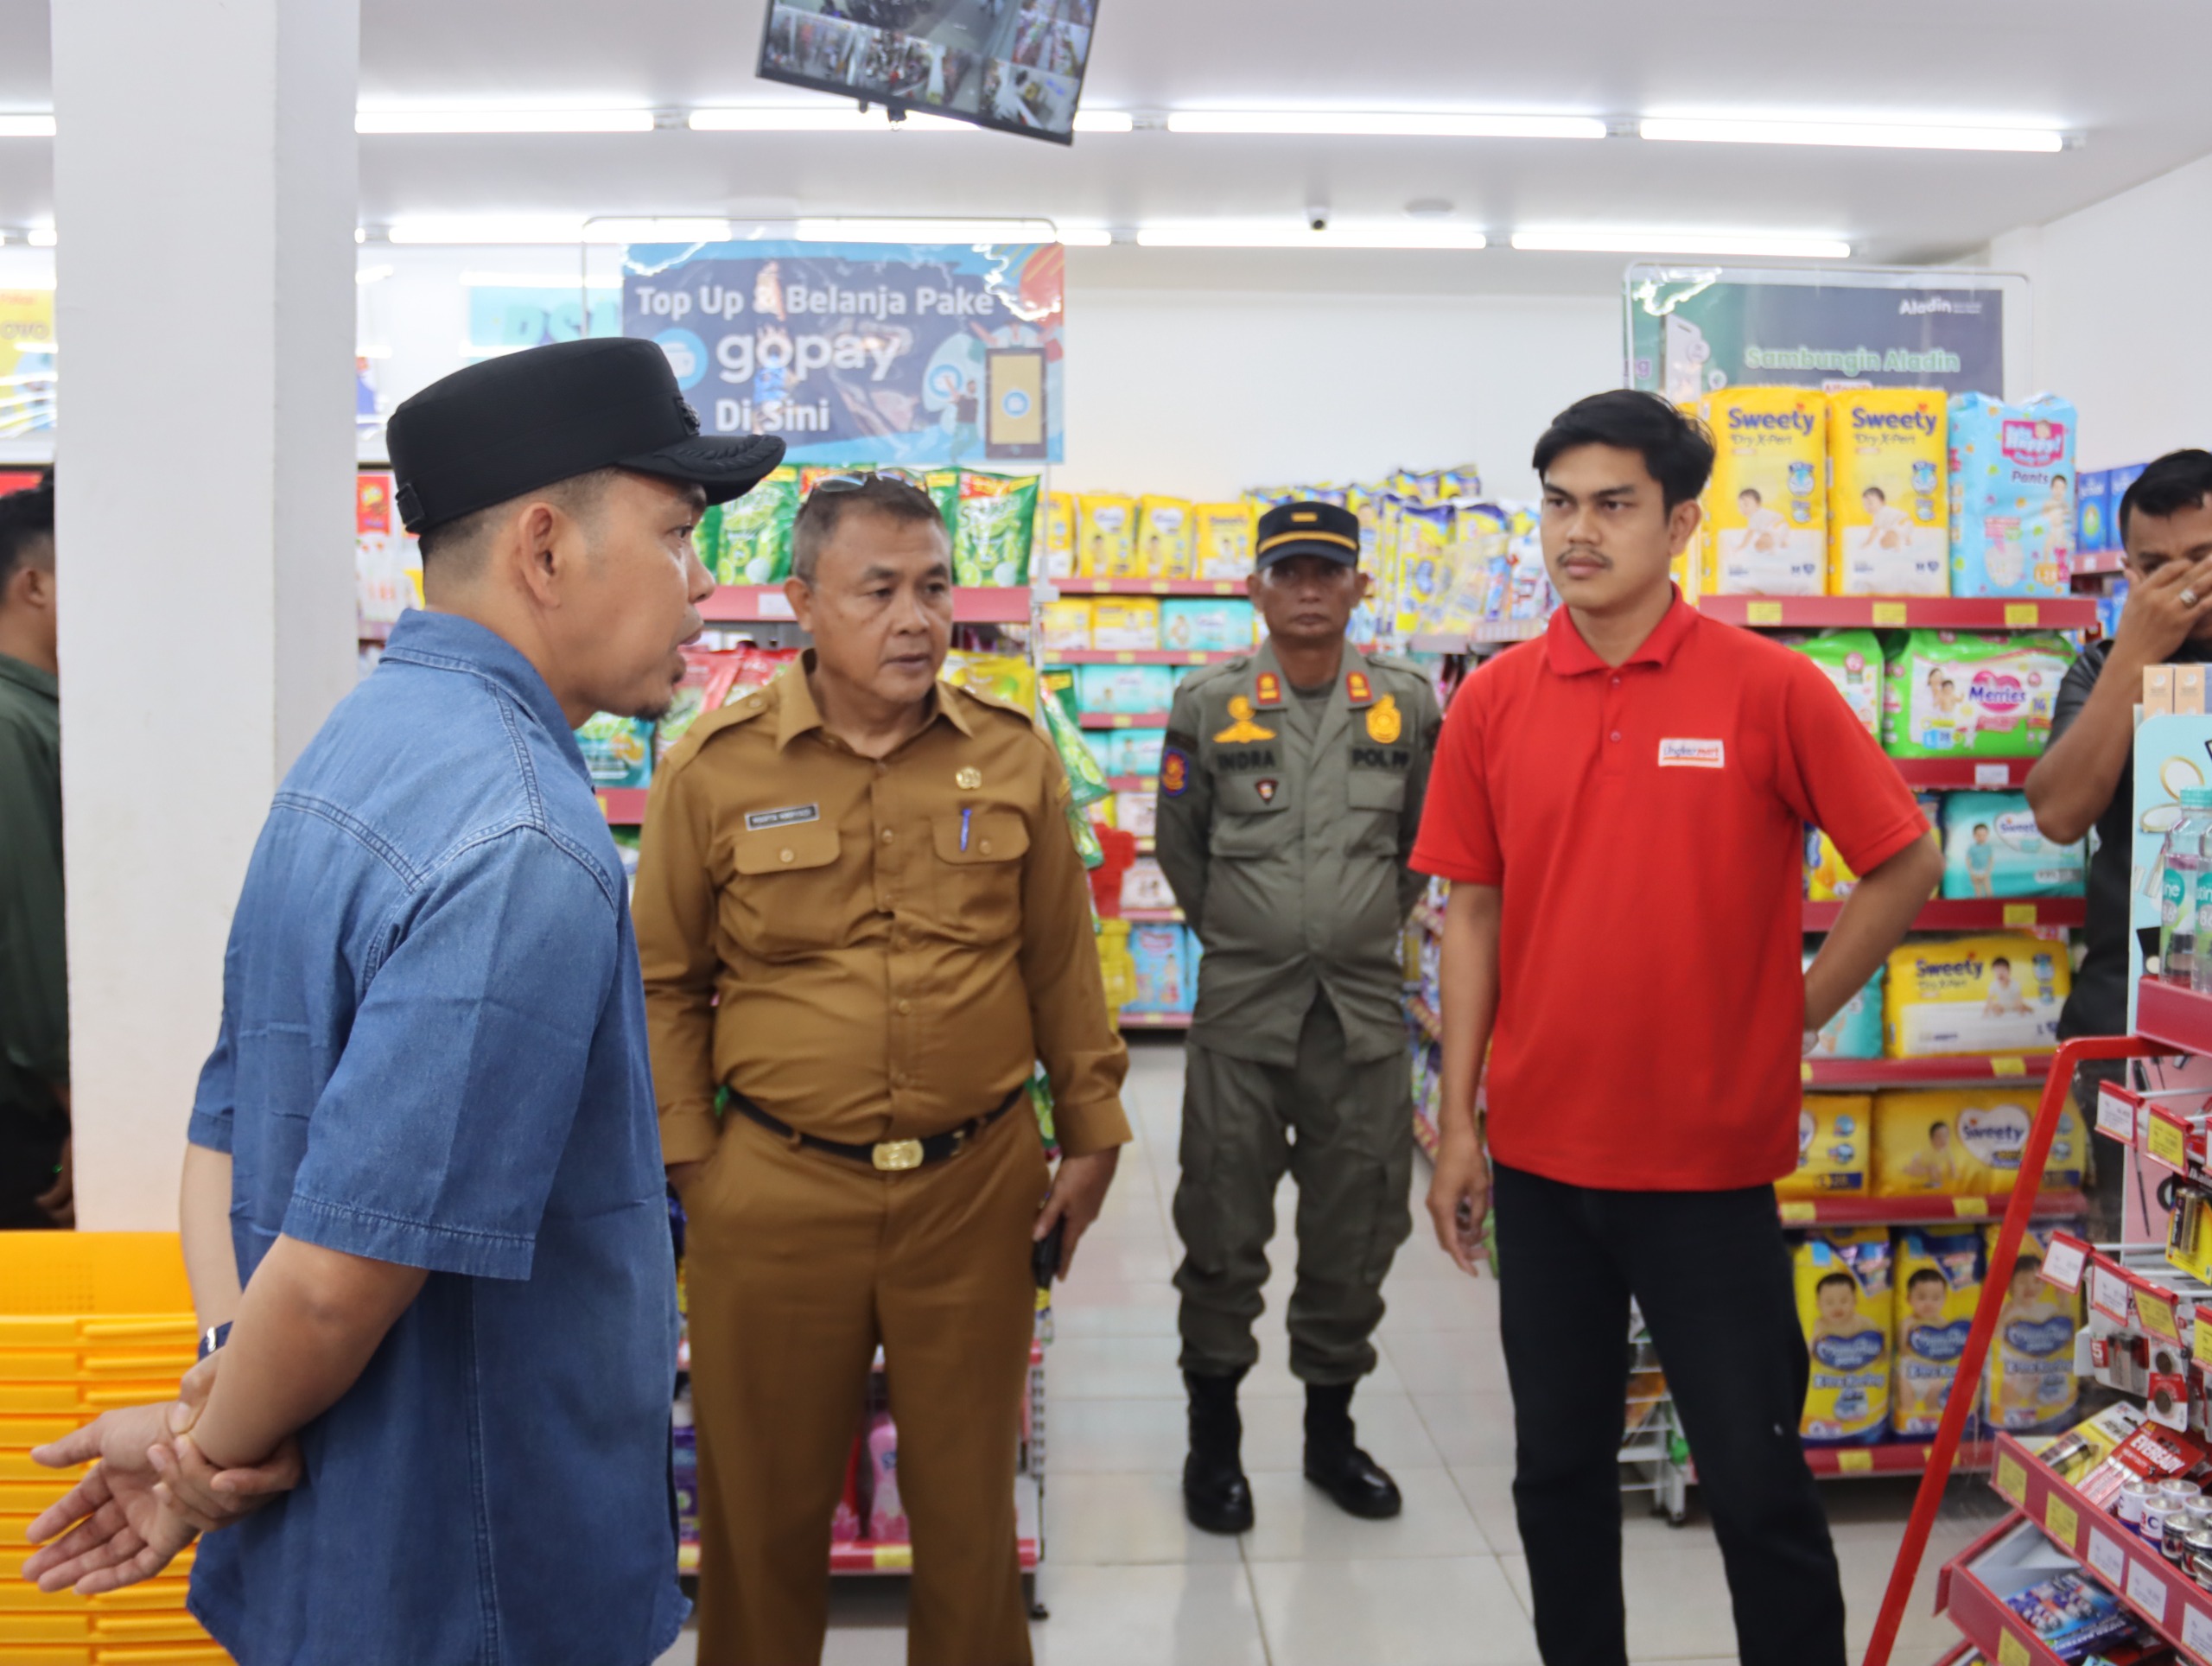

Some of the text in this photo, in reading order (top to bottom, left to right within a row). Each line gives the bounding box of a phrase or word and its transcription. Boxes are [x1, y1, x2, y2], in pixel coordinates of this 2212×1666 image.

[636, 287, 691, 321] Top
[700, 287, 745, 321] Up
[787, 287, 906, 321] Belanja
[916, 287, 995, 316] Pake
[1899, 297, 1953, 315] Aladin
[716, 335, 903, 382] gopay
[1745, 345, 1961, 378] Sambungin Aladin
[716, 398, 830, 432] Di Sini
[1728, 407, 1815, 436] Sweety
[1852, 407, 1937, 436] Sweety
[2012, 471, 2049, 485] Pants
[1969, 686, 2026, 704] Merries
[1217, 750, 1276, 771] INDRA
[1915, 958, 1983, 978] Sweety
[1963, 1124, 2024, 1141] Sweety
[2131, 1434, 2185, 1473] EVEREADY
